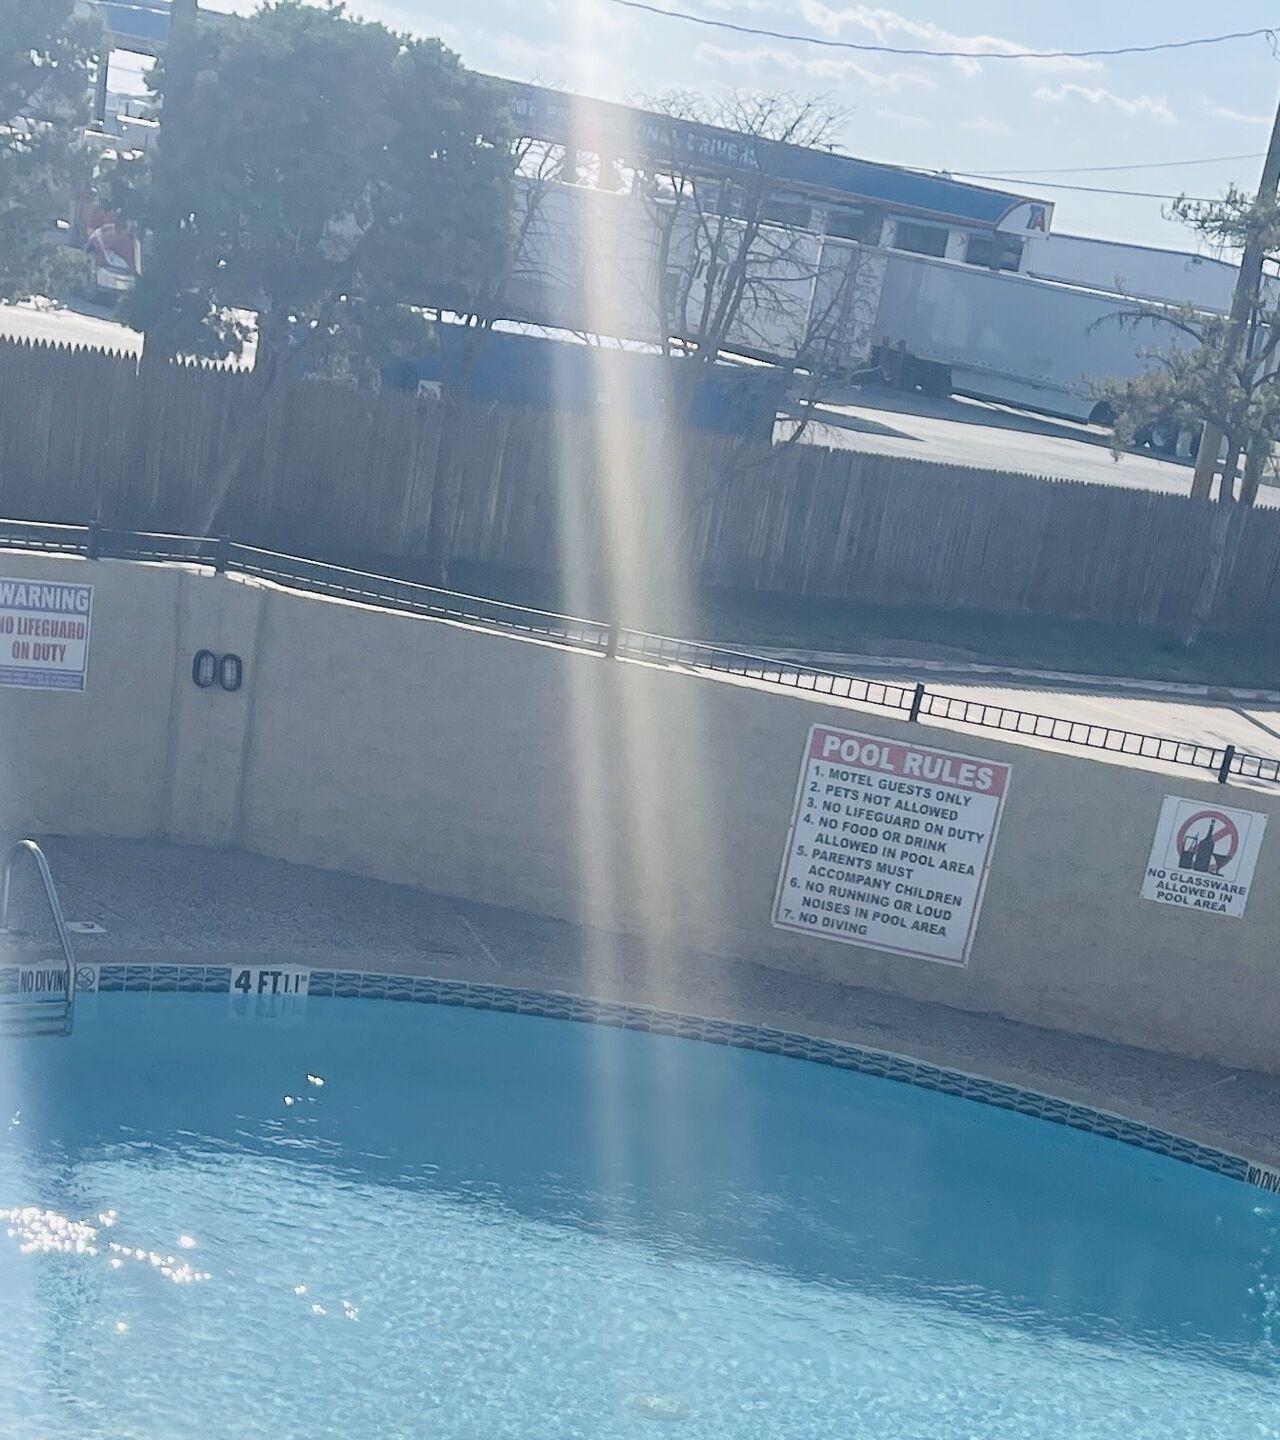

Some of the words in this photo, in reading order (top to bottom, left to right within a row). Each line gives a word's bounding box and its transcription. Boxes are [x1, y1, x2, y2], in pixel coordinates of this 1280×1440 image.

[17, 617, 85, 640] LIFEGUARD
[11, 640, 29, 659] ON
[32, 643, 66, 662] DUTY
[822, 735, 895, 773] POOL
[903, 753, 993, 790] RULES
[810, 782, 821, 794] 2.
[825, 784, 859, 801] PETS
[863, 793, 892, 807] NOT
[894, 799, 958, 820] ALLOWED
[813, 766, 825, 778] 1.
[829, 768, 873, 786] MOTEL
[879, 779, 931, 798] GUESTS
[936, 790, 972, 807] ONLY
[819, 817, 837, 829] NO
[842, 821, 877, 838] FOOD
[882, 830, 900, 843] OR
[905, 835, 949, 852] DRINK
[822, 800, 841, 813] NO
[846, 806, 919, 830] LIFEGUARD
[925, 822, 944, 835] ON
[948, 828, 985, 843] DUTY
[812, 849, 871, 870] PARENTS
[876, 862, 914, 879] MUST
[815, 833, 878, 854] ALLOWED
[883, 847, 895, 857] IN
[900, 851, 935, 867] POOL
[938, 859, 975, 876] AREA
[808, 865, 891, 890] ACCOMPANY
[895, 883, 962, 906] CHILDREN
[1148, 869, 1166, 878] NO
[1170, 873, 1247, 895] GLASSWARE
[1156, 881, 1215, 899] ALLOWED
[1220, 894, 1233, 903] IN
[805, 880, 824, 894] NO
[829, 886, 889, 907] RUNNING
[894, 899, 912, 912] OR
[916, 904, 952, 920] LOUD
[1157, 891, 1189, 905] POOL
[1194, 900, 1227, 912] AREA
[798, 912, 817, 925] NO
[822, 917, 868, 935] DIVING
[802, 896, 850, 915] NOISES
[855, 908, 868, 918] IN
[873, 912, 907, 928] POOL
[911, 920, 946, 936] AREA
[21, 970, 34, 992] NO
[235, 970, 251, 993] 4
[1247, 1166, 1261, 1185] NO
